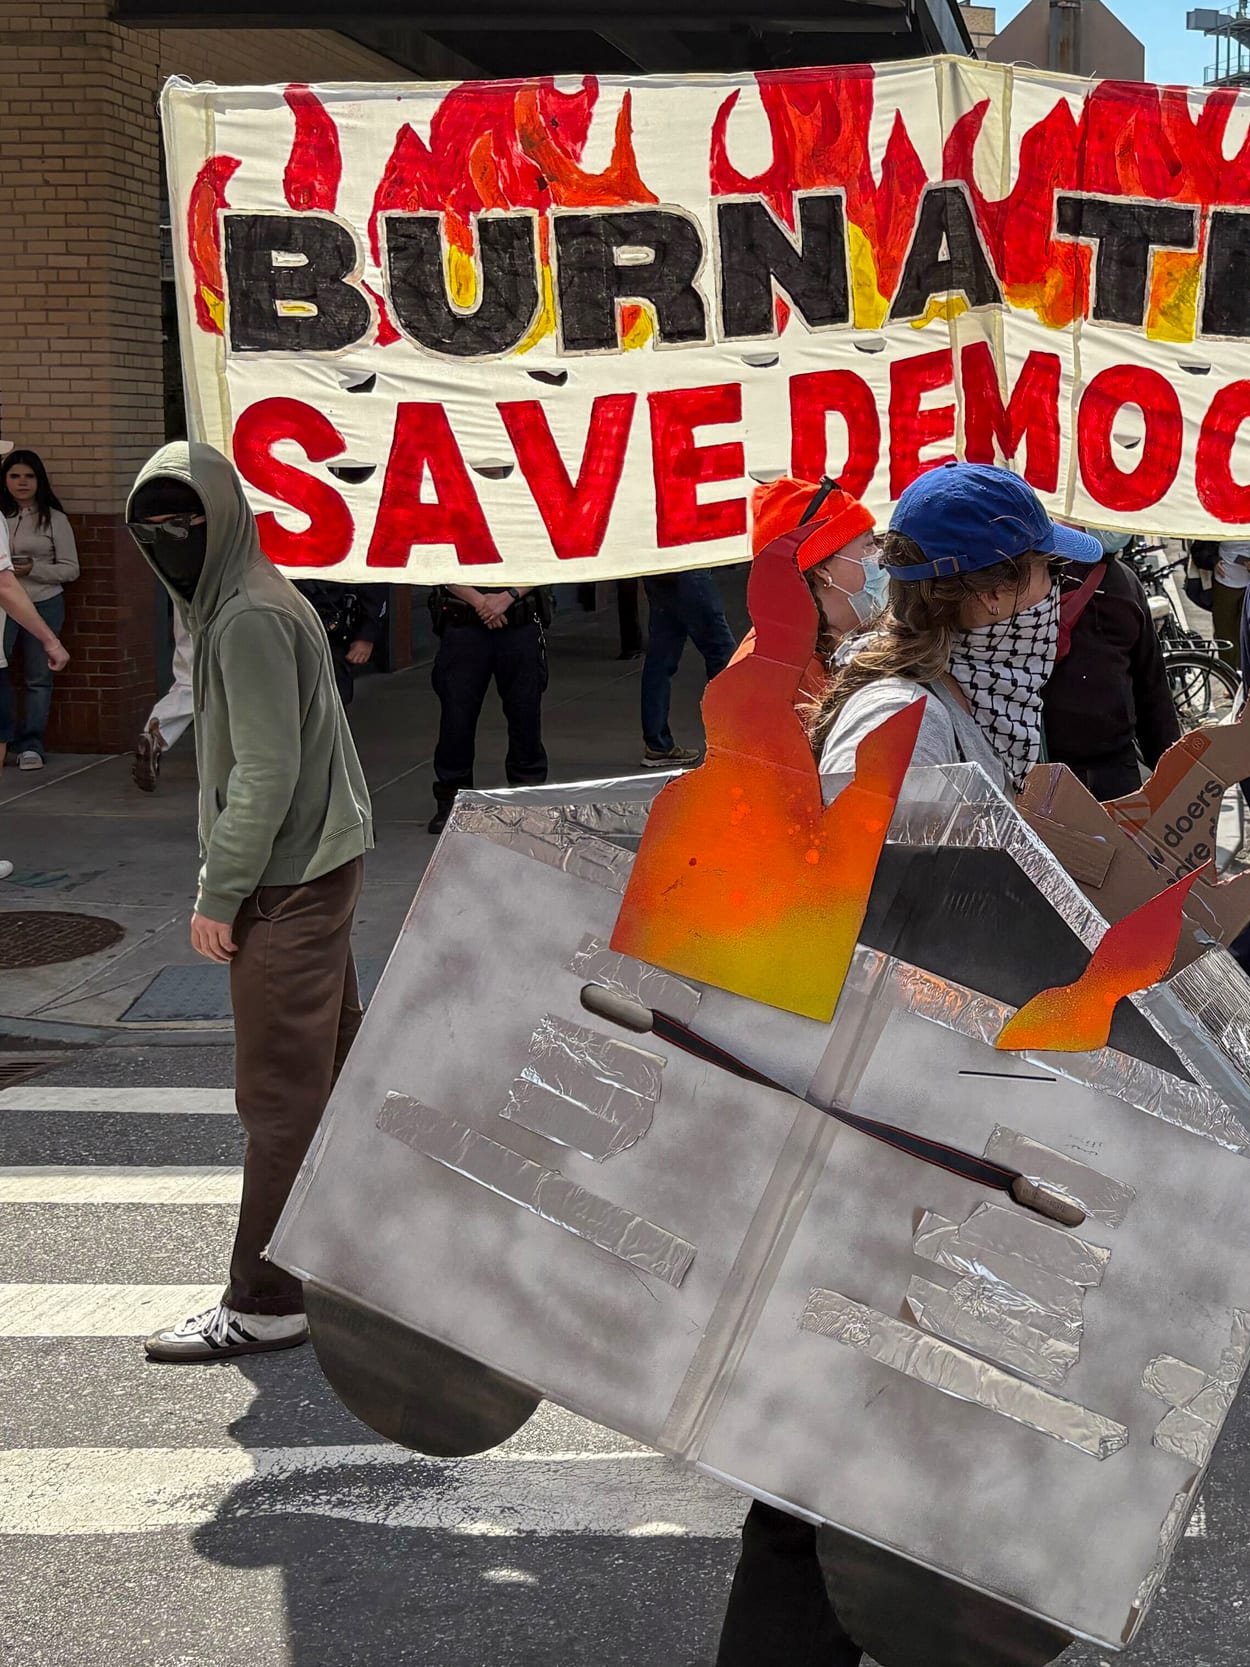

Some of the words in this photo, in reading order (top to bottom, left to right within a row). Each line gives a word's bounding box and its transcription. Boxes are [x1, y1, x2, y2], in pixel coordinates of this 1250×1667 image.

[219, 187, 854, 360] BURN
[888, 180, 1003, 324] A
[233, 382, 748, 568] SAVE
[1163, 780, 1225, 848] doers
